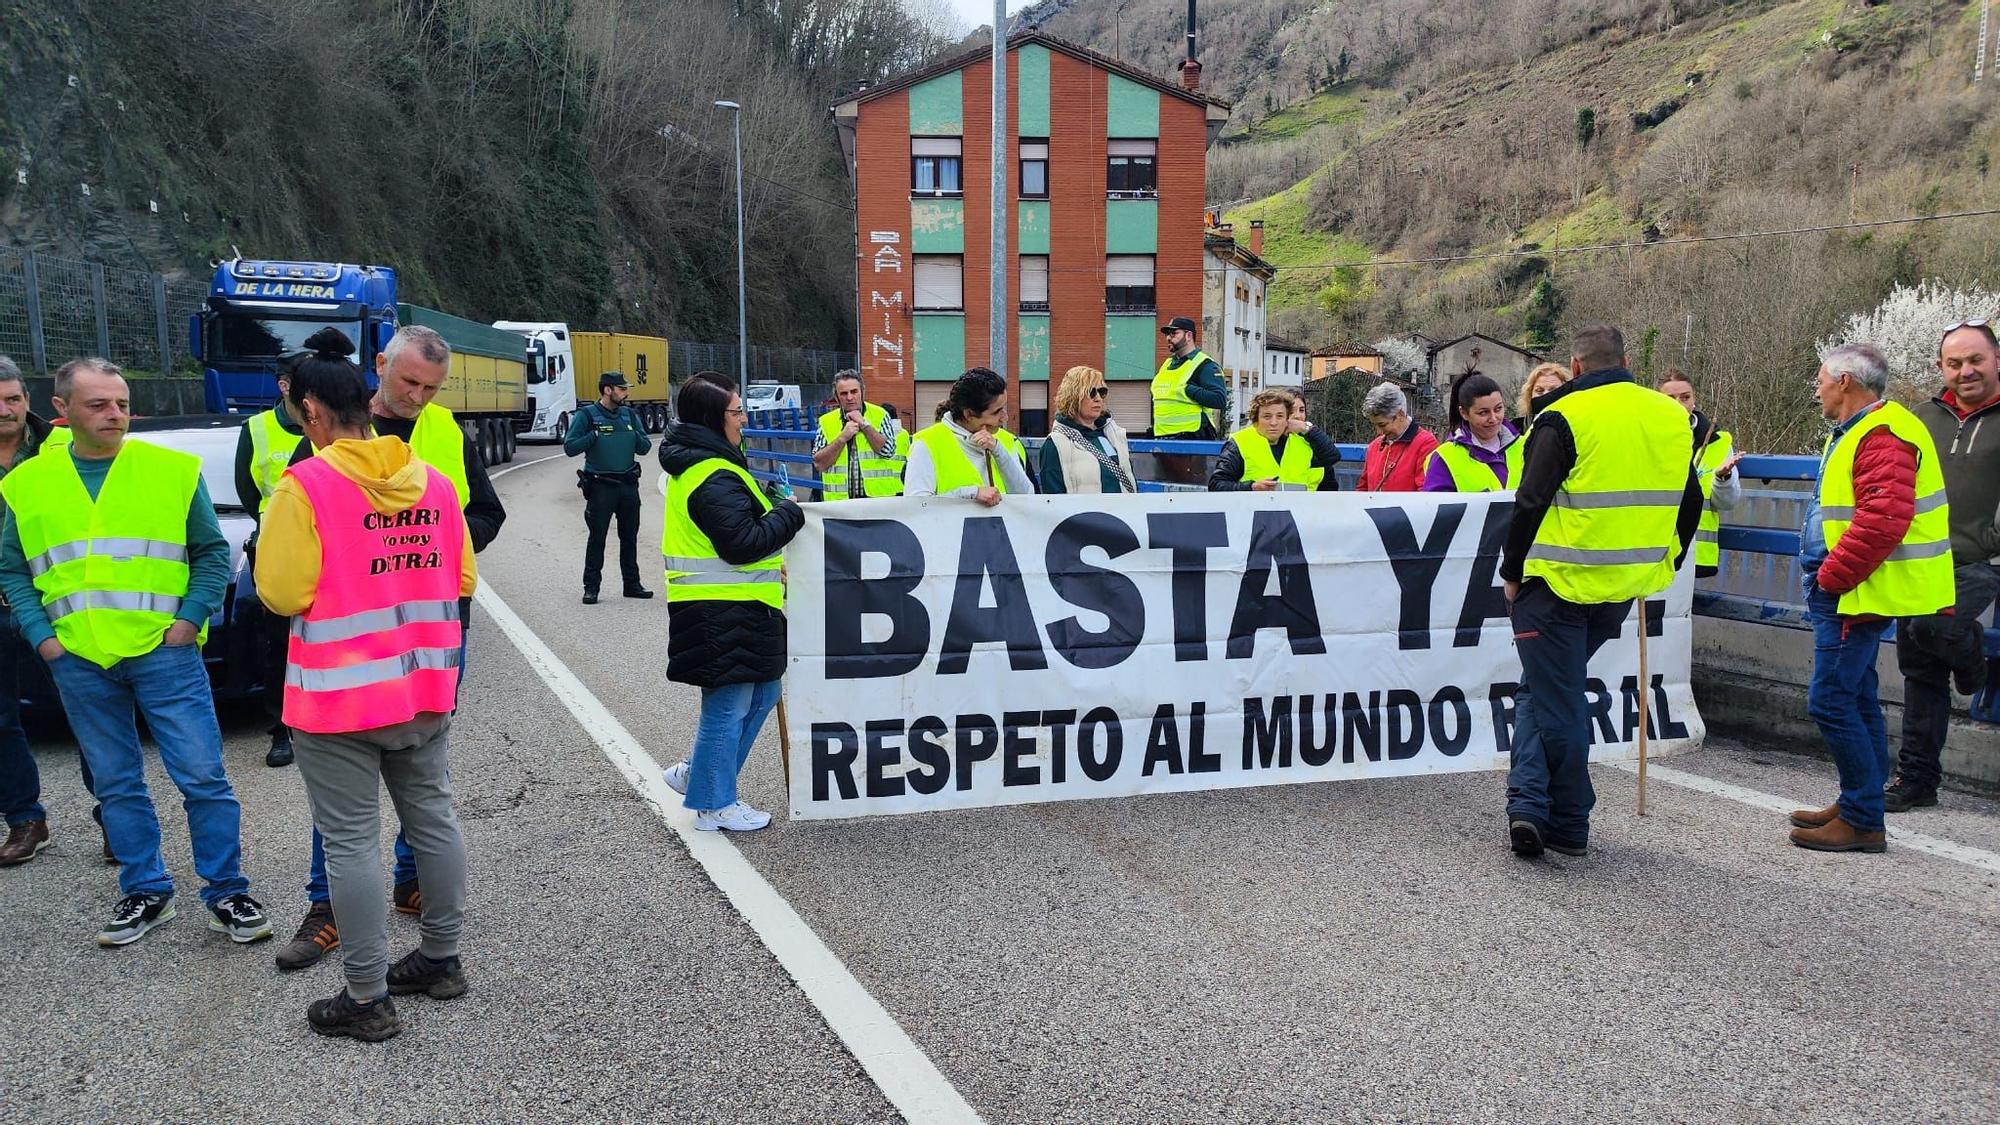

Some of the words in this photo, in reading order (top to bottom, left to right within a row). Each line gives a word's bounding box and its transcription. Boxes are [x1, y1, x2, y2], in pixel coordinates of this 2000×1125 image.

[235, 282, 259, 295] DE
[262, 283, 284, 296] LA
[288, 284, 335, 299] HERA
[400, 534, 431, 547] voy
[822, 509, 1327, 680] BASTA
[811, 706, 1123, 801] RESPETO
[1142, 701, 1221, 776] AL
[1242, 685, 1472, 770] MUNDO
[1489, 674, 1690, 752] RRAL
